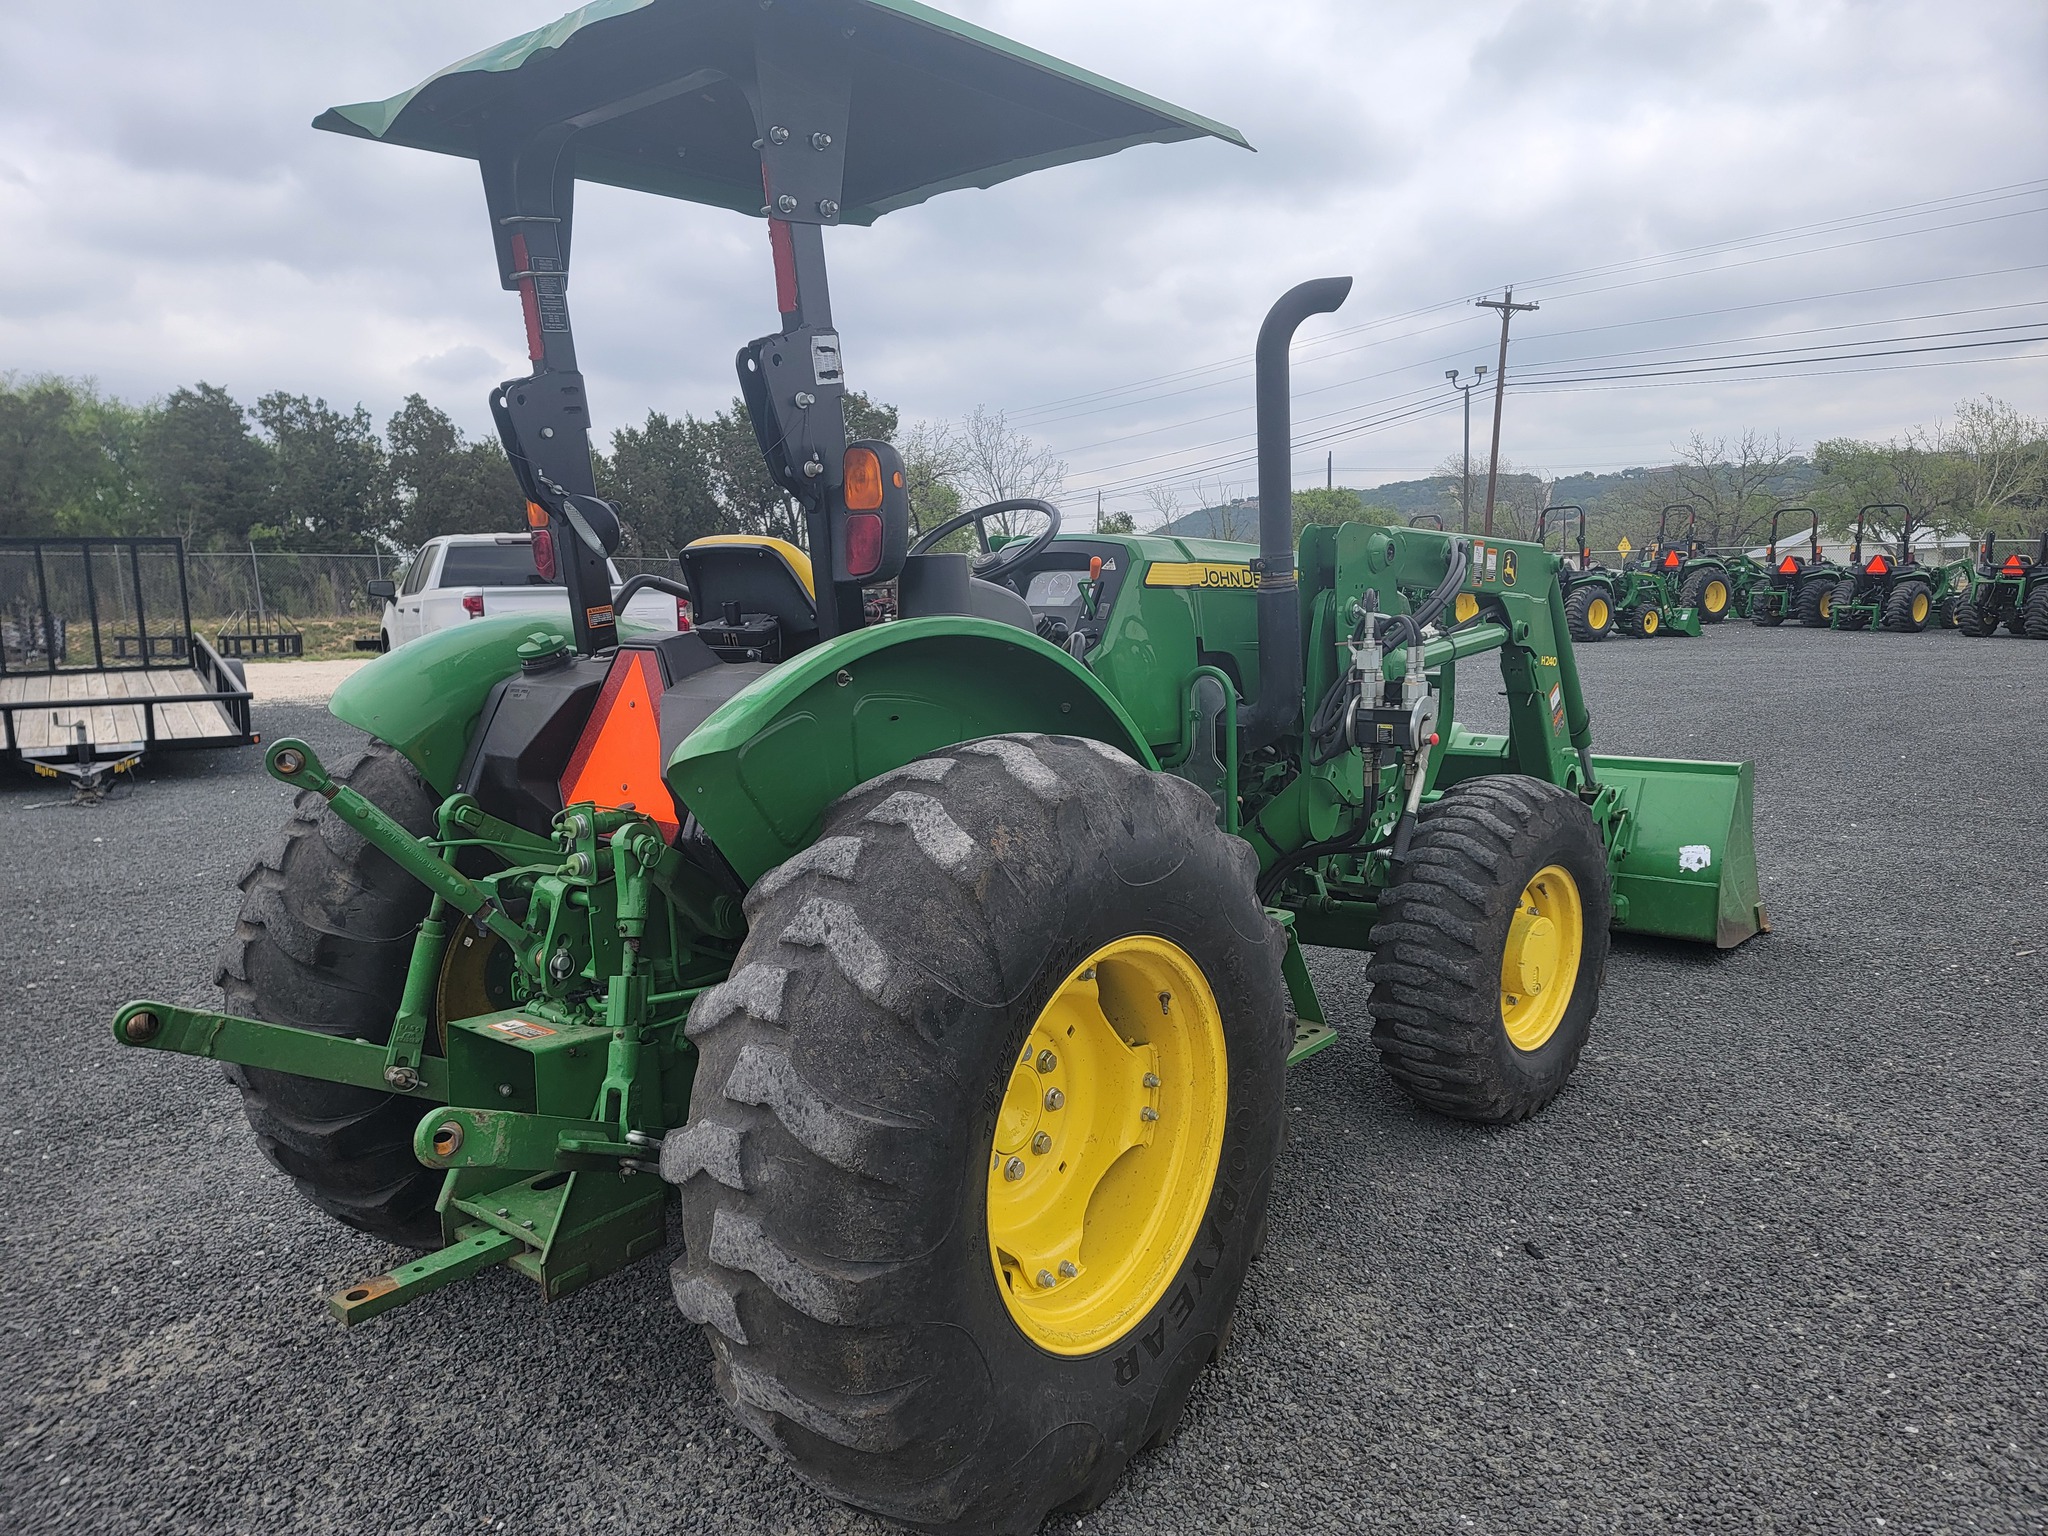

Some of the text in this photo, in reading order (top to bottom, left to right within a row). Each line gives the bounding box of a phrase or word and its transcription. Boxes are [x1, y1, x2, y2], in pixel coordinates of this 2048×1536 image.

[1201, 567, 1240, 586] JOHN
[1540, 655, 1558, 667] H240
[1113, 1066, 1258, 1389] GOODYEAR
